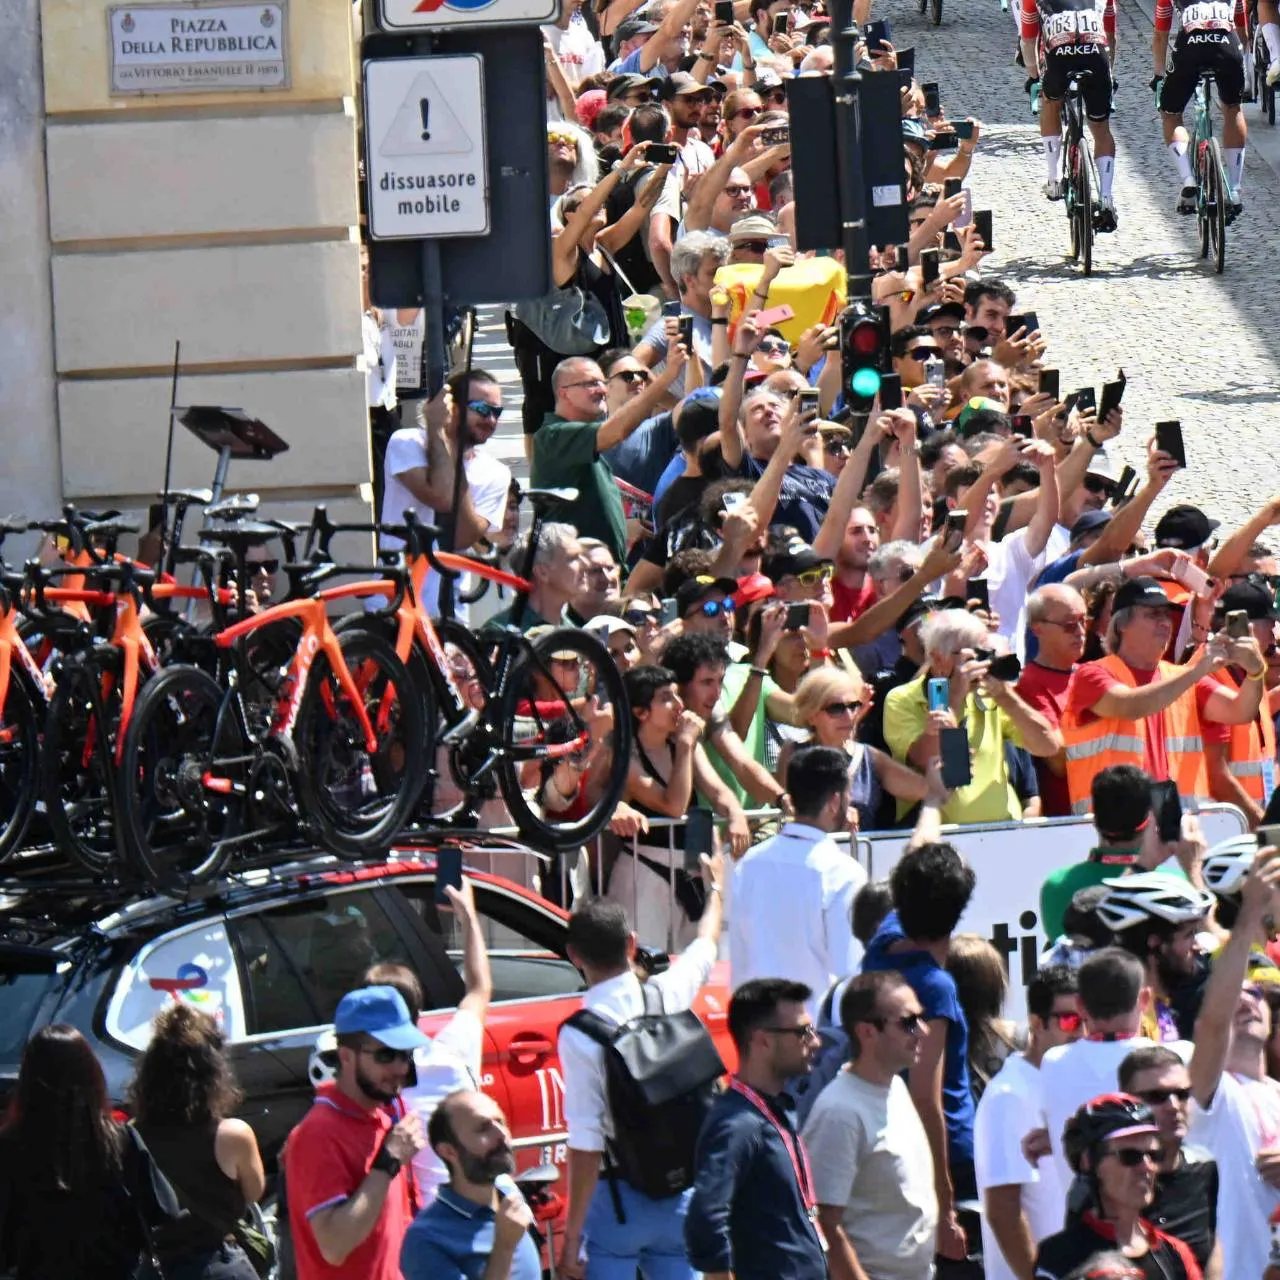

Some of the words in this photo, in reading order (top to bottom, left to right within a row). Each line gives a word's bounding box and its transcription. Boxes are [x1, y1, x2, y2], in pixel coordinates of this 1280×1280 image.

[171, 18, 227, 33] PIAZZA
[122, 40, 166, 55] DELLA
[171, 35, 277, 53] REPUBBLICA
[1188, 33, 1230, 45] ARKEA
[1056, 44, 1100, 56] ARKEA
[134, 67, 185, 79] VITTORIO
[188, 66, 242, 77] EMANUELE
[380, 172, 476, 192] dissuasore
[398, 196, 461, 216] mobile
